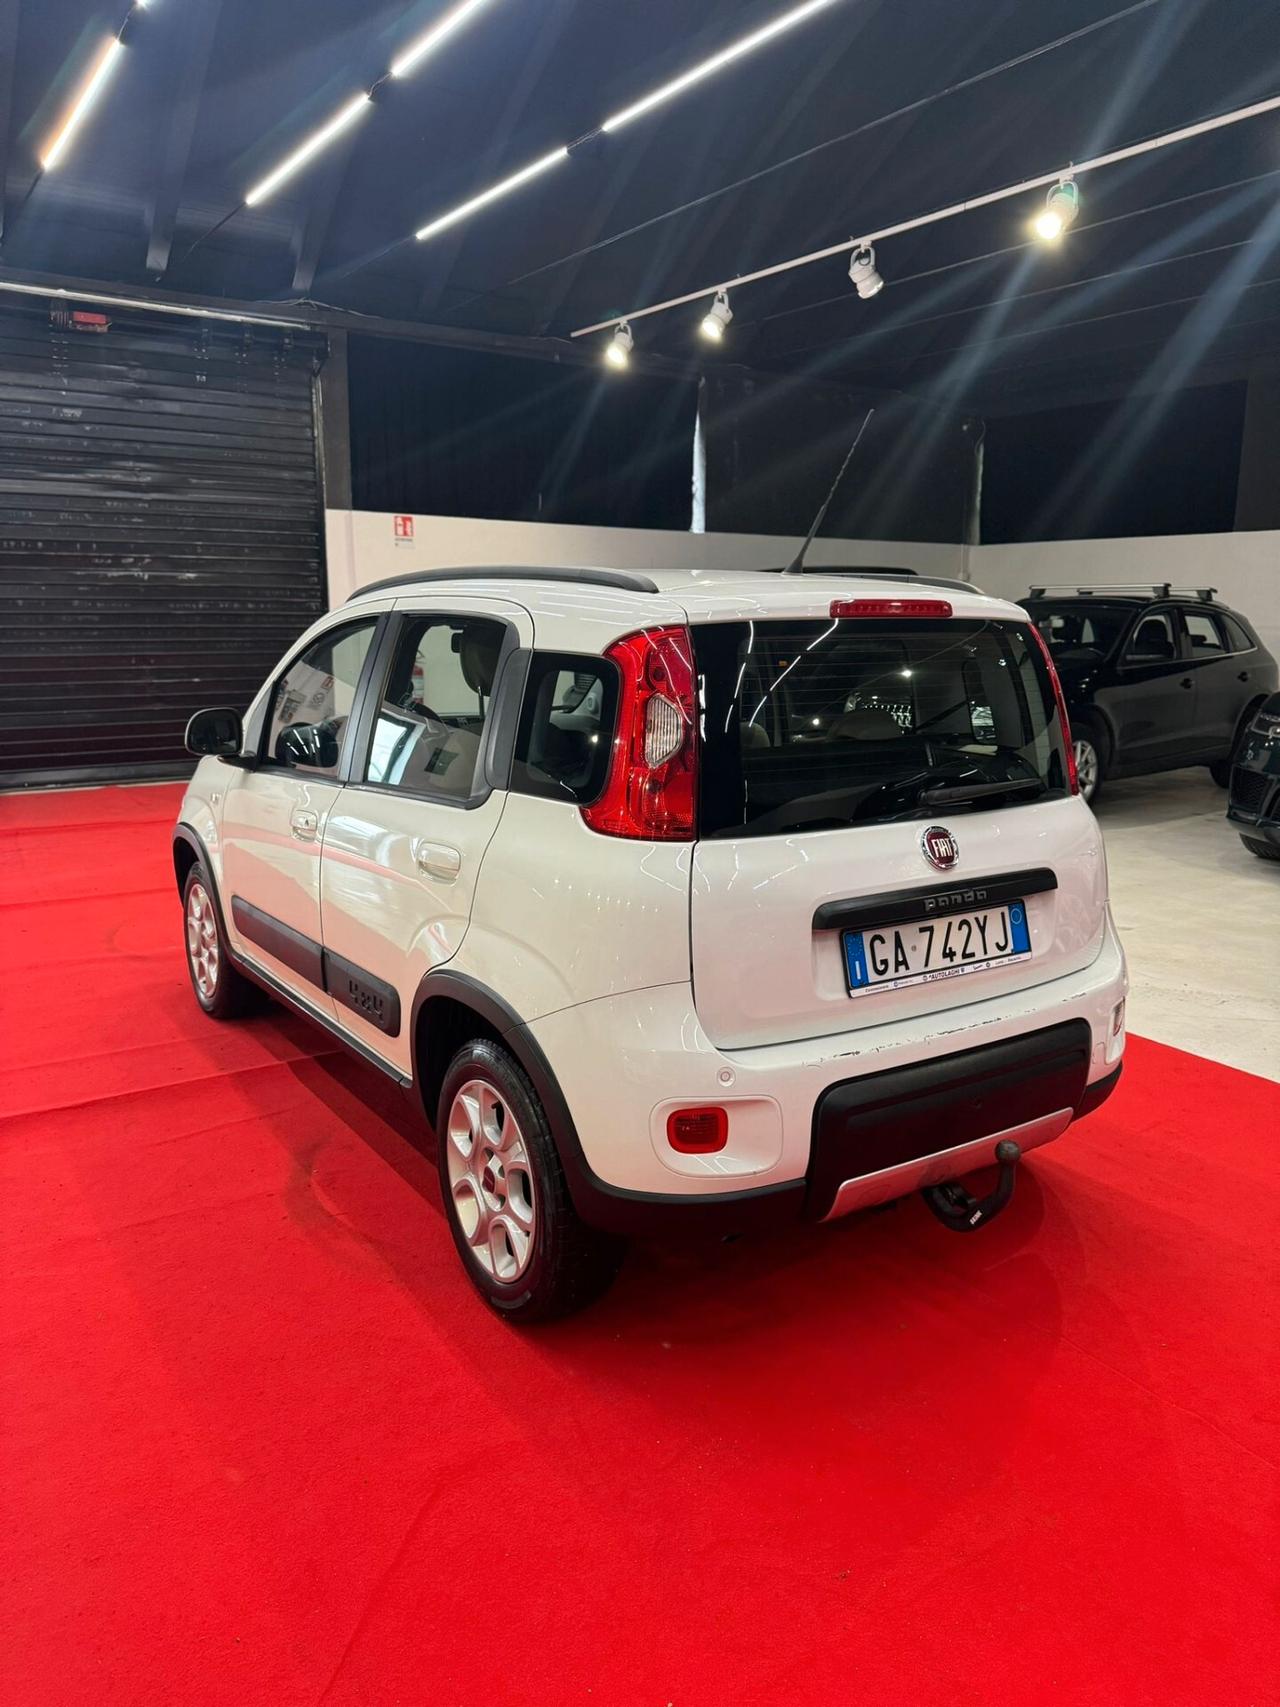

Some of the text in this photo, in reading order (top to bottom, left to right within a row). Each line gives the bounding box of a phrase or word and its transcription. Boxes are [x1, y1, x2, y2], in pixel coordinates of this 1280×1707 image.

[931, 838, 953, 858] FIAT
[924, 889, 987, 911] panda
[869, 931, 910, 976] GA
[919, 912, 1010, 968] 742YJ
